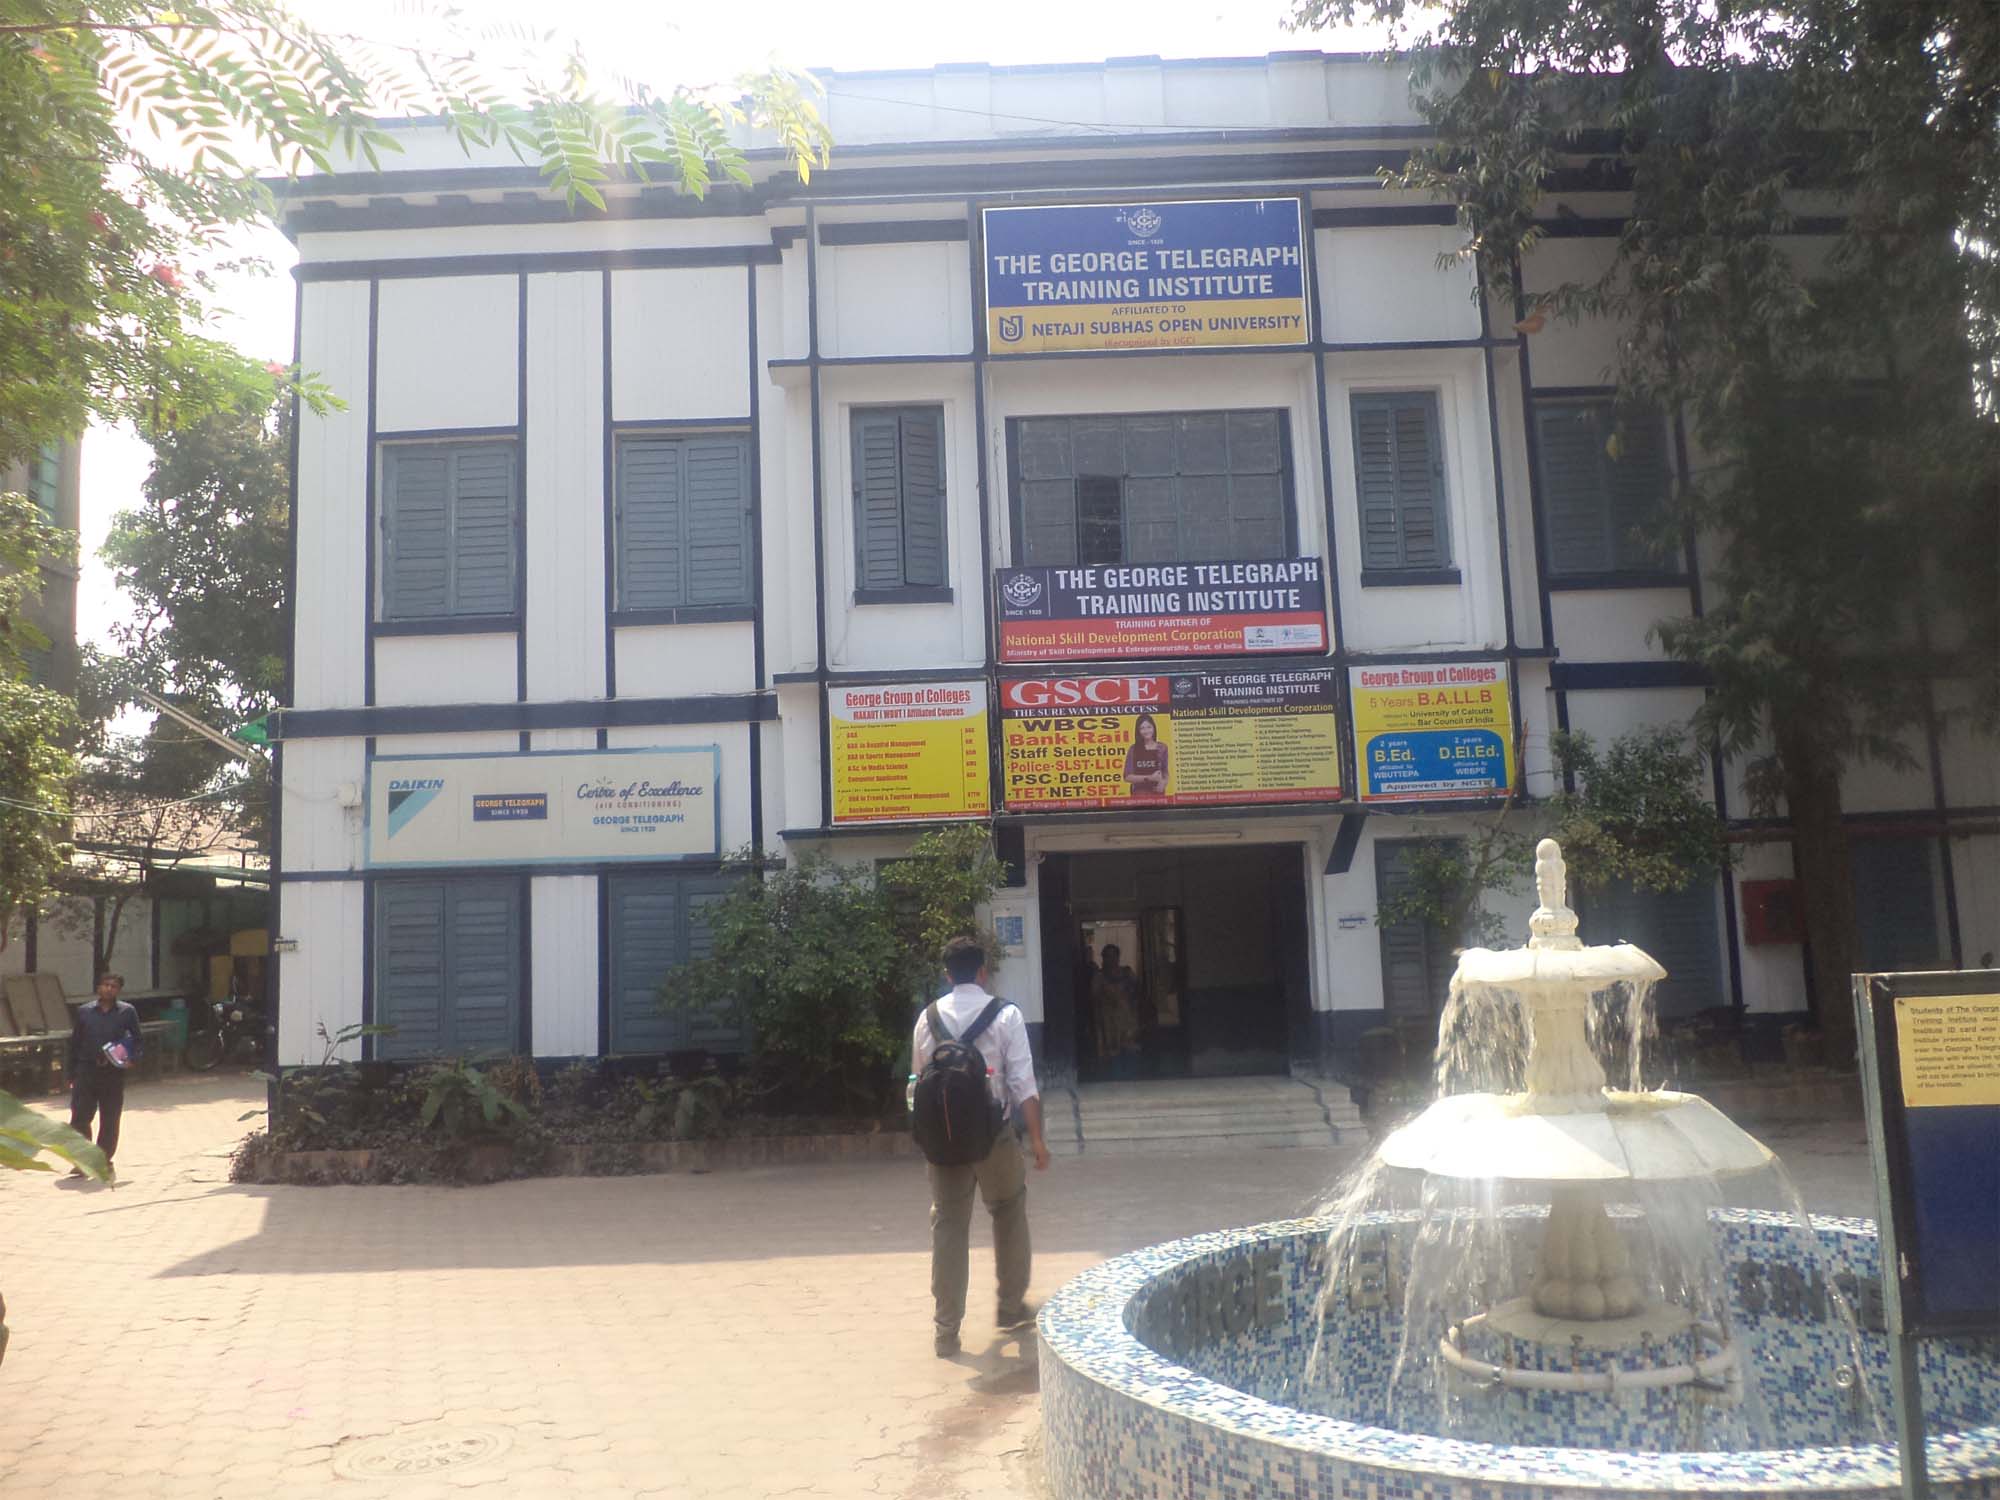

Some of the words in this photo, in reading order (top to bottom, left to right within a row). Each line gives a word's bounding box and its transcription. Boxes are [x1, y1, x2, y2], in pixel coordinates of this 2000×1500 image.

[994, 255, 1042, 275] THE
[1050, 251, 1148, 274] GEORGE
[1156, 246, 1299, 270] TELEGRAPH
[1022, 279, 1140, 300] TRAINING
[1148, 274, 1273, 297] INSTITUTE
[1112, 305, 1168, 316] AFFILIATED
[1172, 304, 1186, 313] TO
[1032, 322, 1084, 336] NETAJI
[1090, 320, 1154, 334] SUBHAS
[1159, 319, 1202, 332] OPEN
[1208, 315, 1300, 331] UNIVERSITY
[1160, 338, 1170, 346] by
[1056, 569, 1096, 590] THE
[1104, 566, 1188, 588] GEORGE
[1194, 562, 1318, 585] TELEGRAPH
[1076, 592, 1180, 615] TRAINING
[1188, 589, 1300, 612] INSTITUTE
[1116, 620, 1156, 629] TRAINING
[1158, 618, 1198, 628] PARTNER
[1200, 618, 1212, 626] OF
[1006, 634, 1056, 646] National
[1060, 632, 1085, 645] Skill
[1088, 631, 1168, 646] Development
[1171, 629, 1242, 642] Corporation
[1006, 649, 1037, 658] Ministry
[1224, 642, 1242, 650] India
[1201, 676, 1222, 685] THE
[1224, 674, 1268, 684] GEORGE
[1272, 672, 1332, 684] TELEGRAPH
[1361, 671, 1400, 686] George
[1402, 670, 1434, 684] Group
[1436, 668, 1447, 682] of
[1449, 667, 1496, 682] Colleges
[846, 693, 882, 706] George
[884, 692, 913, 705] Group
[915, 690, 925, 703] of
[927, 688, 971, 704] Colleges
[1010, 677, 1159, 706] GSCE
[1214, 686, 1262, 697] TRAINING
[1266, 684, 1320, 696] INSTITUTE
[1370, 698, 1377, 708] 5
[1380, 696, 1414, 708] Years
[938, 708, 964, 716] Courses
[1013, 709, 1040, 718] THE
[1042, 708, 1066, 716] SURE
[1068, 707, 1091, 715] WAY
[1094, 706, 1108, 714] TO
[1111, 705, 1158, 714] SUCCESS
[1172, 708, 1206, 718] National
[1209, 708, 1227, 716] Skill
[1229, 706, 1282, 716] Development
[1284, 703, 1334, 714] Corporation
[1410, 710, 1452, 718] University
[1022, 717, 1120, 732] WBCS
[1010, 733, 1070, 747] Bank
[1078, 731, 1130, 744] Rail
[1388, 740, 1408, 748] years
[1010, 748, 1048, 760] Staff
[1054, 746, 1126, 758] Selection
[1375, 749, 1416, 762] B.Ed.
[1440, 745, 1500, 760] D.El.Ed.
[1010, 760, 1050, 772] Police
[1056, 759, 1090, 771] SLST
[1096, 758, 1124, 770] LIC
[1136, 760, 1156, 768] GSCE
[389, 779, 444, 790] DAIKIN
[1012, 774, 1052, 785] PSC
[1060, 772, 1121, 784] Defence
[577, 784, 616, 798] Centre
[620, 782, 637, 800] of
[638, 780, 703, 798] Excellence
[1013, 788, 1046, 798] TET
[1050, 786, 1083, 798] NET
[1087, 784, 1120, 796] SET
[1386, 782, 1436, 790] Approved
[476, 800, 503, 808] GEORGE
[505, 798, 544, 806] TELEGRAPH
[617, 800, 682, 808] CONDITIONING)
[592, 816, 630, 824] GEORGE
[632, 814, 684, 824] TELEGRAPH
